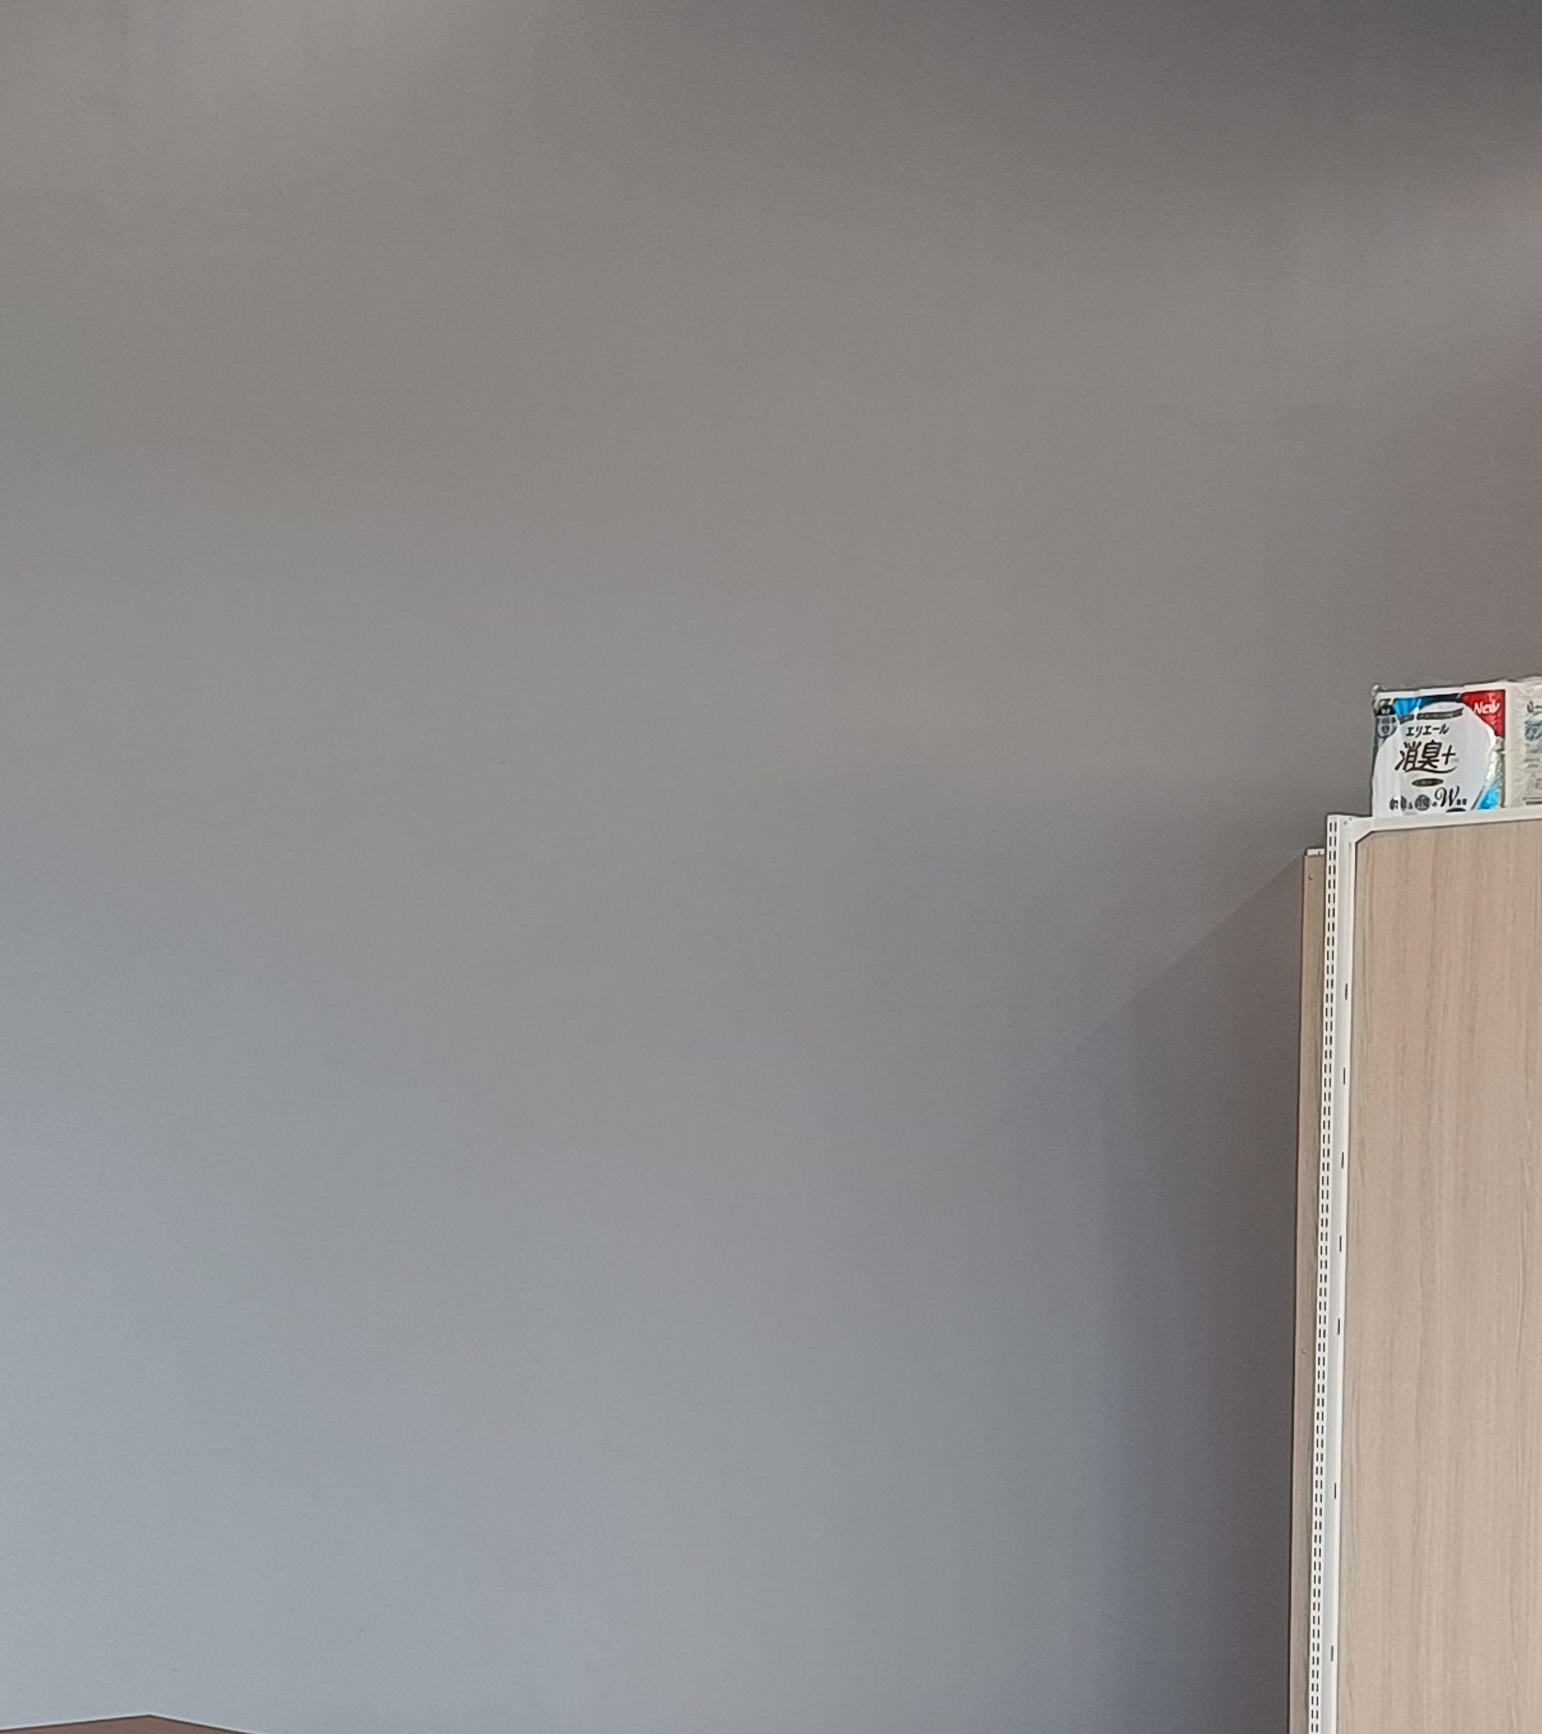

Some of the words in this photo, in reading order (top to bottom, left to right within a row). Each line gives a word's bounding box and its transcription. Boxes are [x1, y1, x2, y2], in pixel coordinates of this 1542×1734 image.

[1472, 701, 1501, 716] New
[1405, 723, 1450, 739] エリエール
